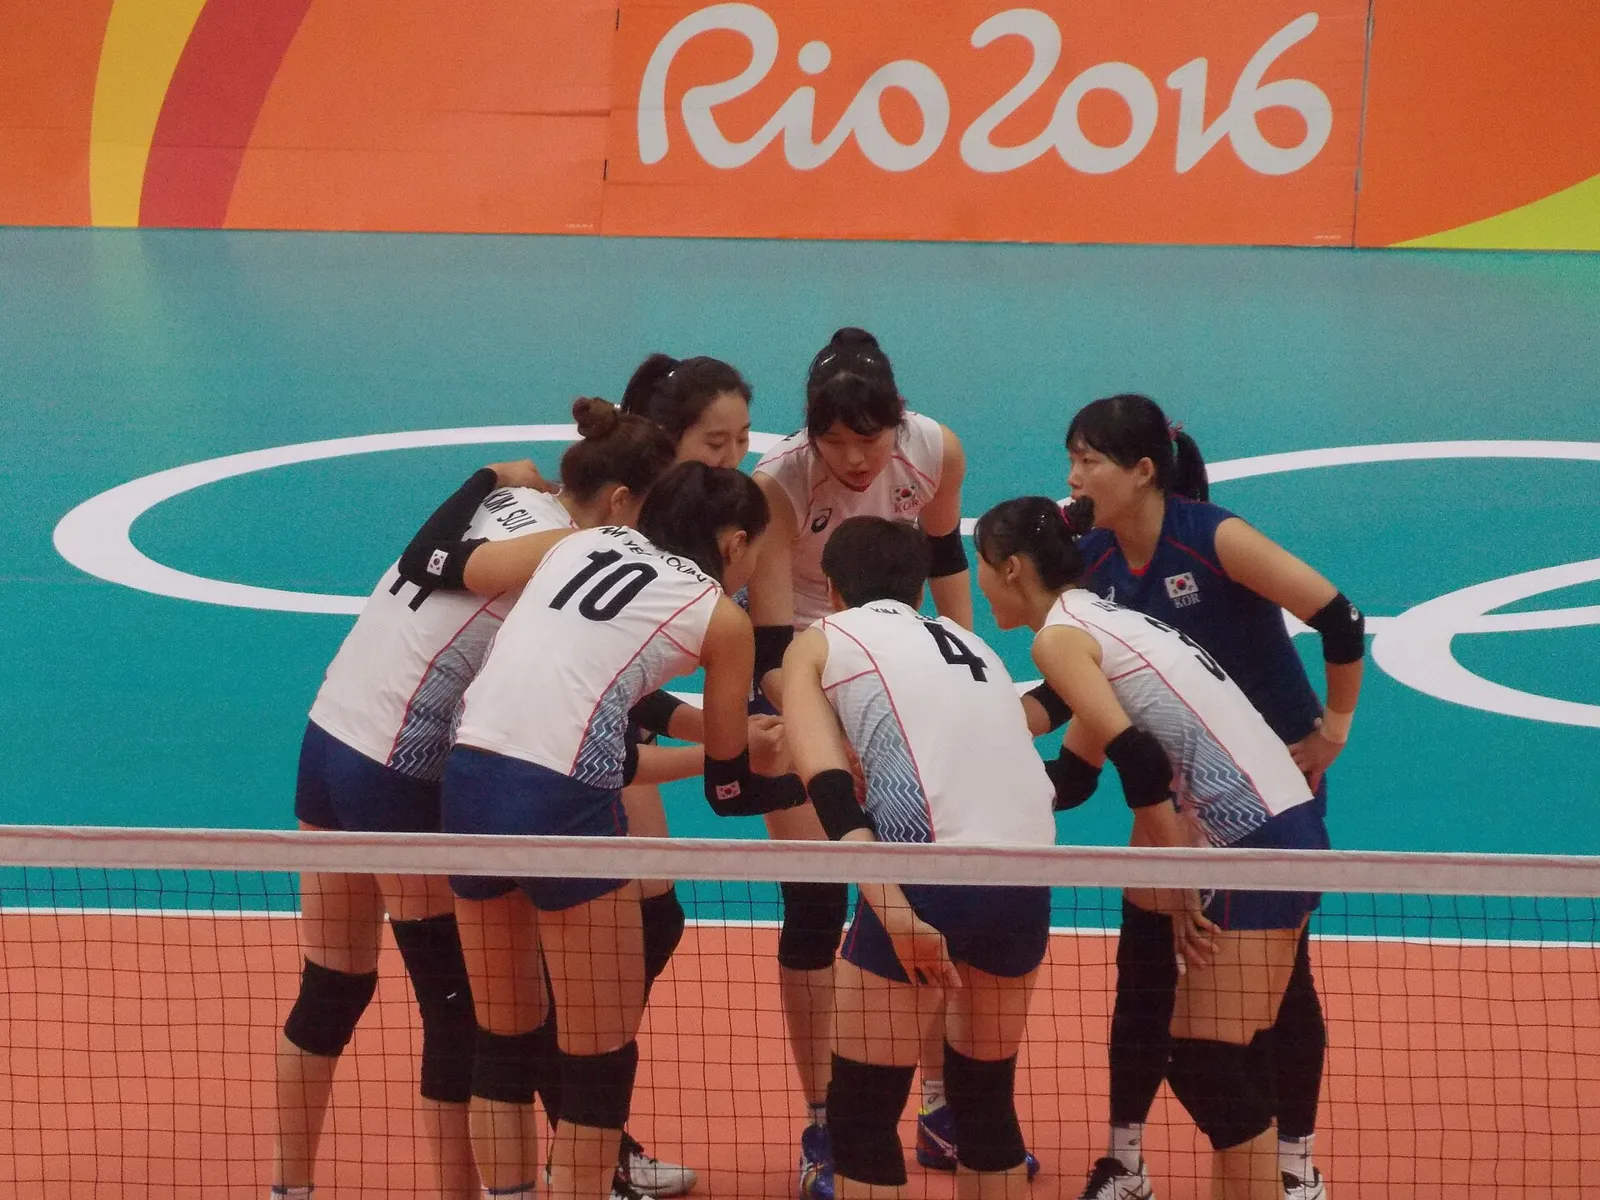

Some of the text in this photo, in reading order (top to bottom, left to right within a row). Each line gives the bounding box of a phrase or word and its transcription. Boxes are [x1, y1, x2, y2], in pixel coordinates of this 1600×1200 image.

[893, 500, 919, 513] KOR
[548, 549, 659, 621] 10
[1173, 592, 1201, 609] KOR
[923, 621, 988, 683] 4
